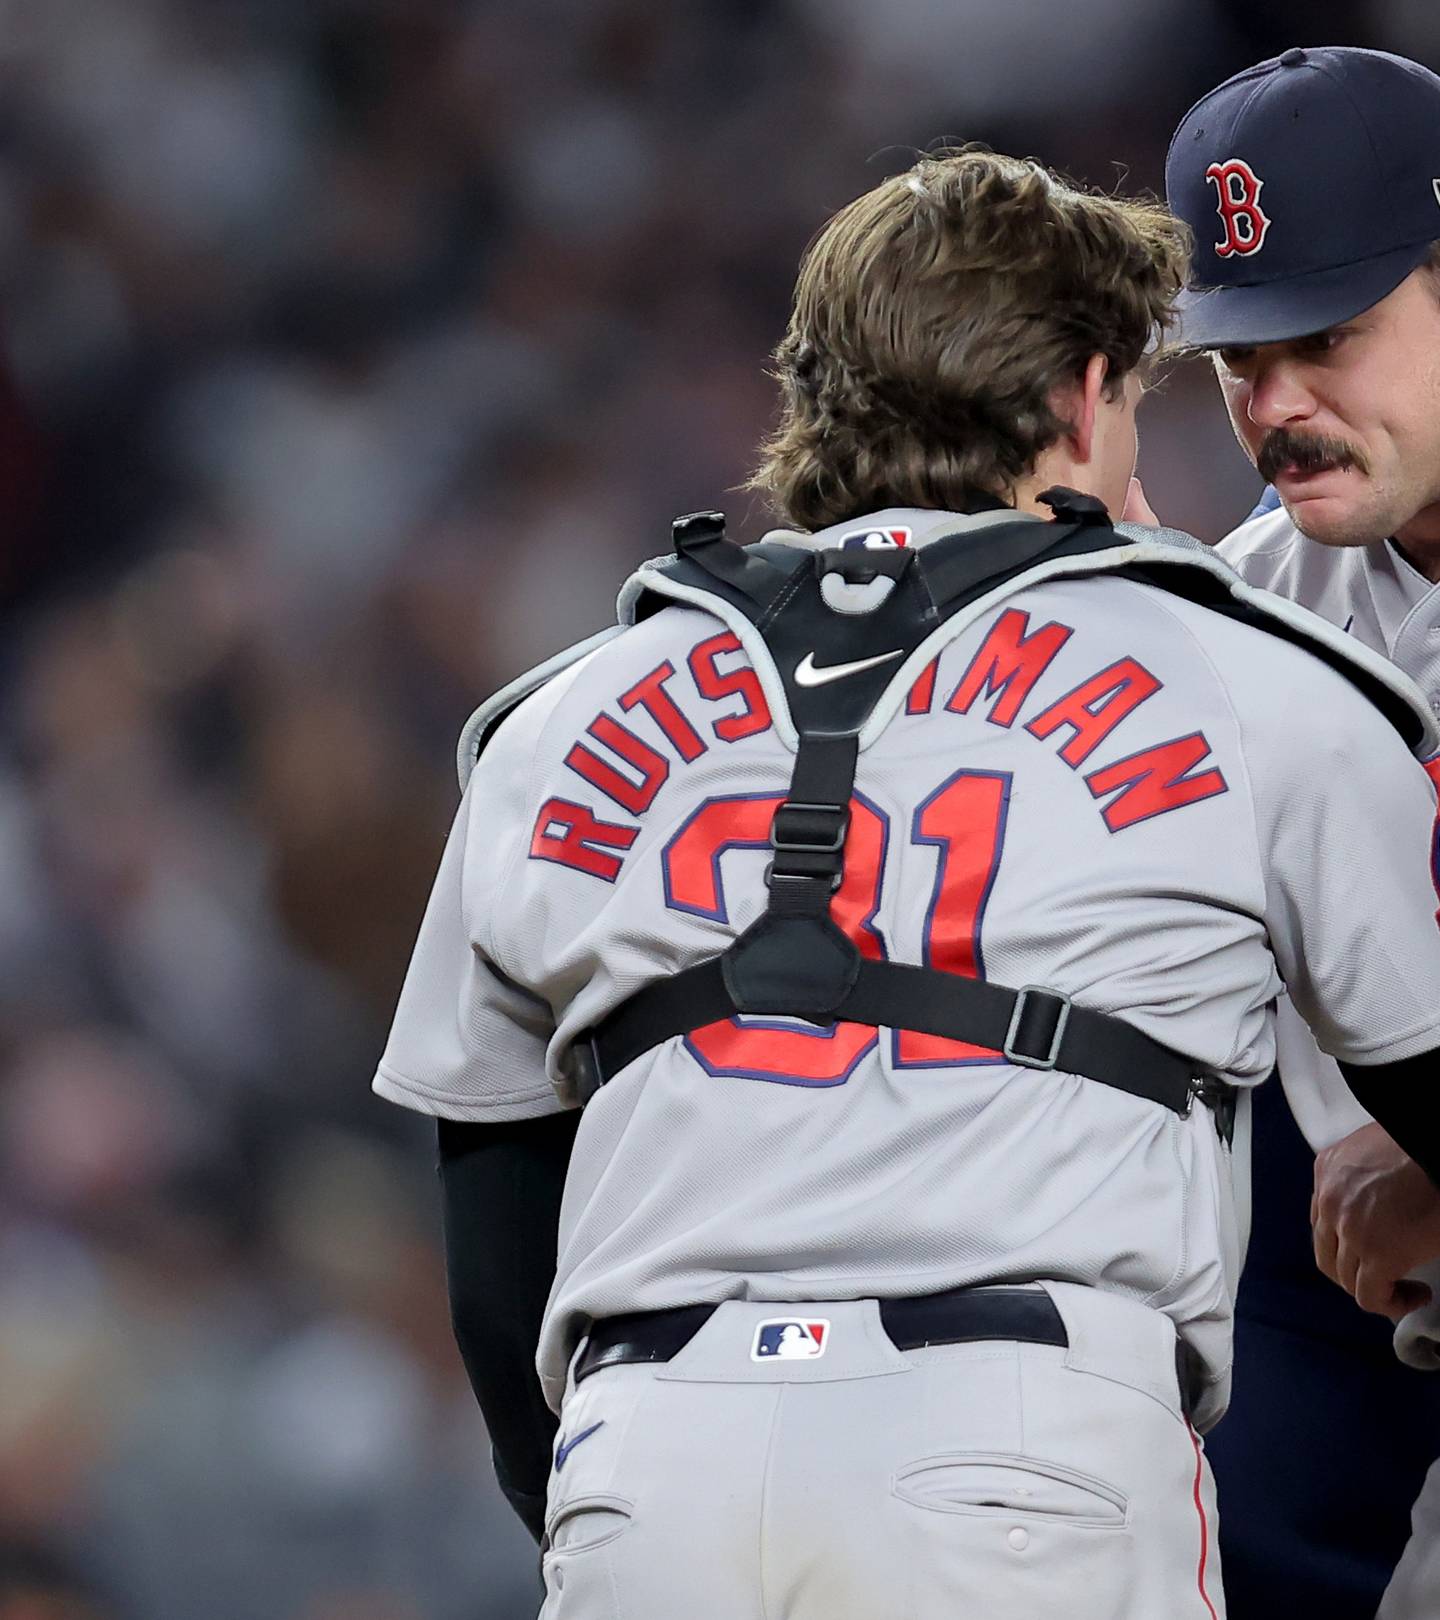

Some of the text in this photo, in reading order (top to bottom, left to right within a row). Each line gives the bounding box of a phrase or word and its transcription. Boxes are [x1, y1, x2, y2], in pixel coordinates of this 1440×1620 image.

[1205, 158, 1272, 258] B
[528, 607, 1230, 883] RUTSMAN
[660, 767, 1013, 1088] 31
